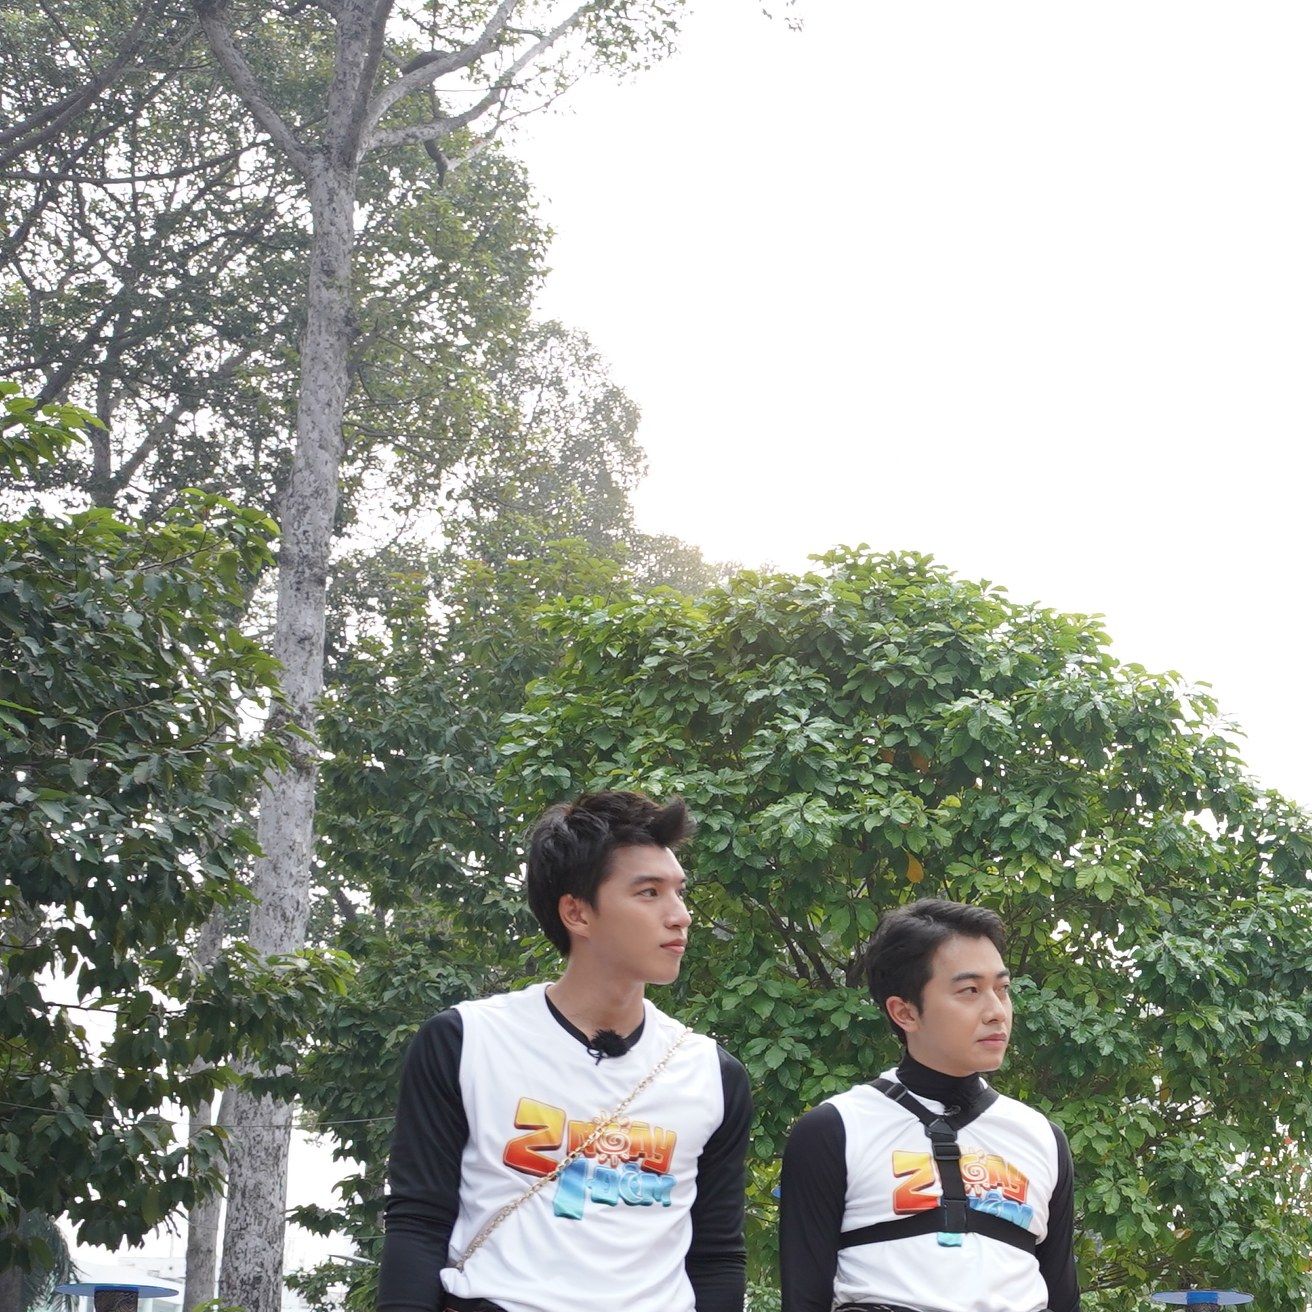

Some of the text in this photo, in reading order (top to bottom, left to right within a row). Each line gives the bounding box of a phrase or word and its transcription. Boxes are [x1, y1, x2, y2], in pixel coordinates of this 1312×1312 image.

[503, 1097, 567, 1181] 2
[553, 1157, 589, 1220] 1
[892, 1151, 1029, 1215] 2 GÀY
